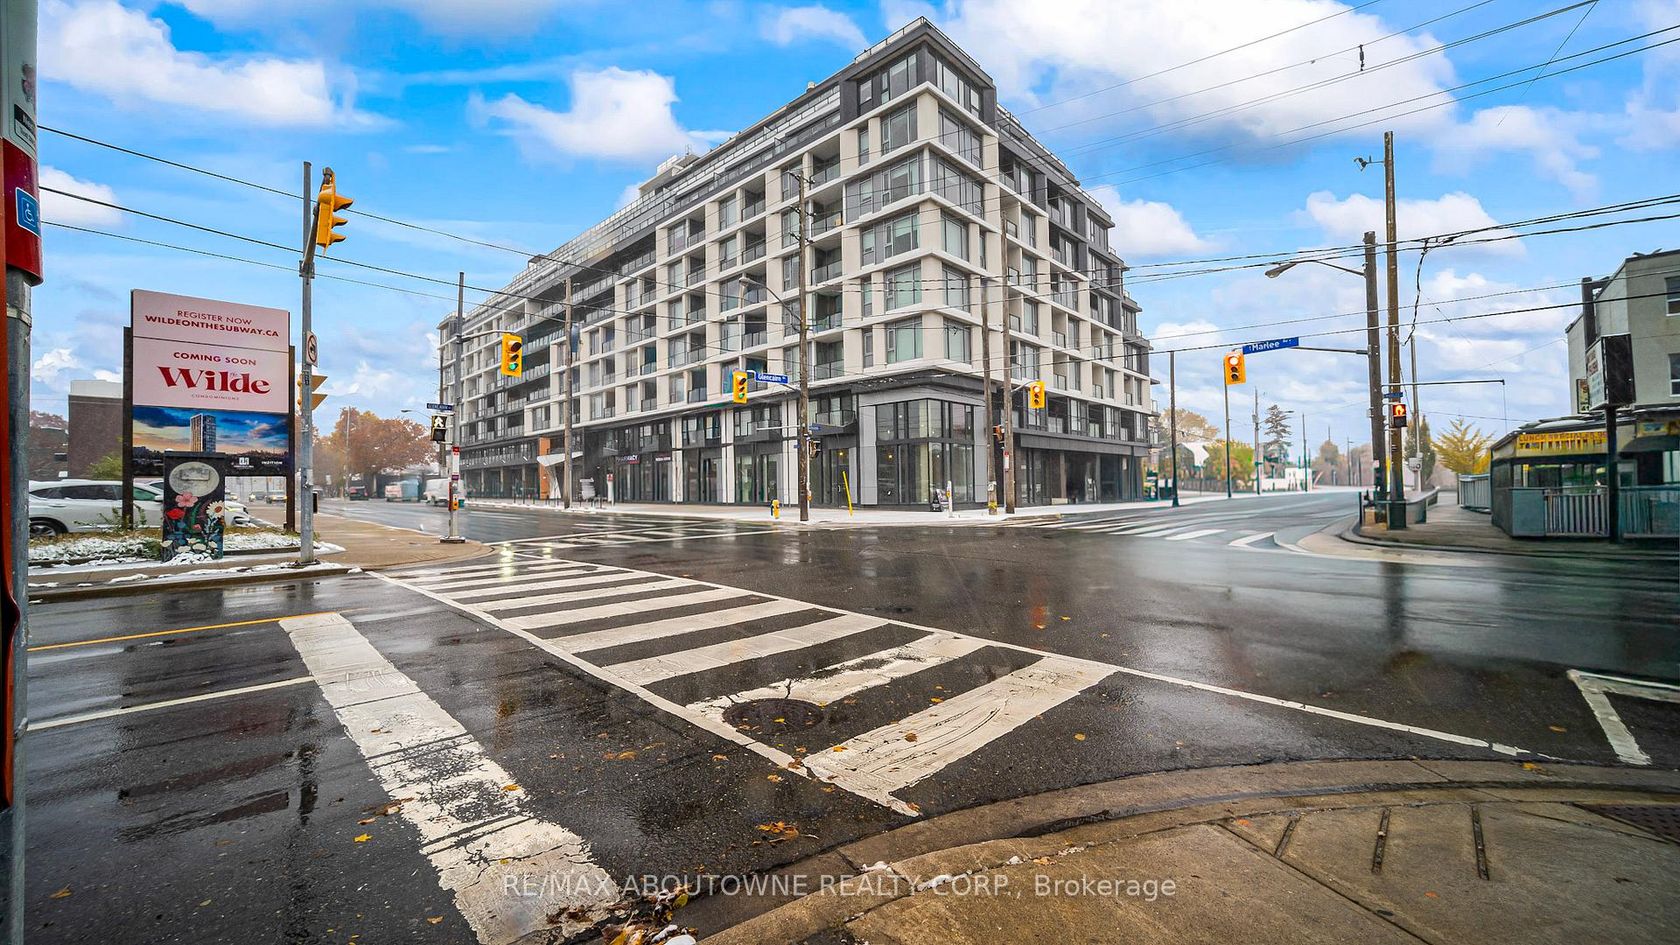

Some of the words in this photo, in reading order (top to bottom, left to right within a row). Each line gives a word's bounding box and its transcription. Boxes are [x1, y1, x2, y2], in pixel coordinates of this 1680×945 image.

[177, 310, 223, 322] REGISTER
[226, 317, 252, 325] NOW
[145, 315, 279, 337] WILDEONTHESUBWAY.CA
[173, 352, 222, 363] COMING
[225, 357, 257, 366] SOON
[157, 366, 271, 394] Wilde
[758, 373, 782, 383] Glencairn
